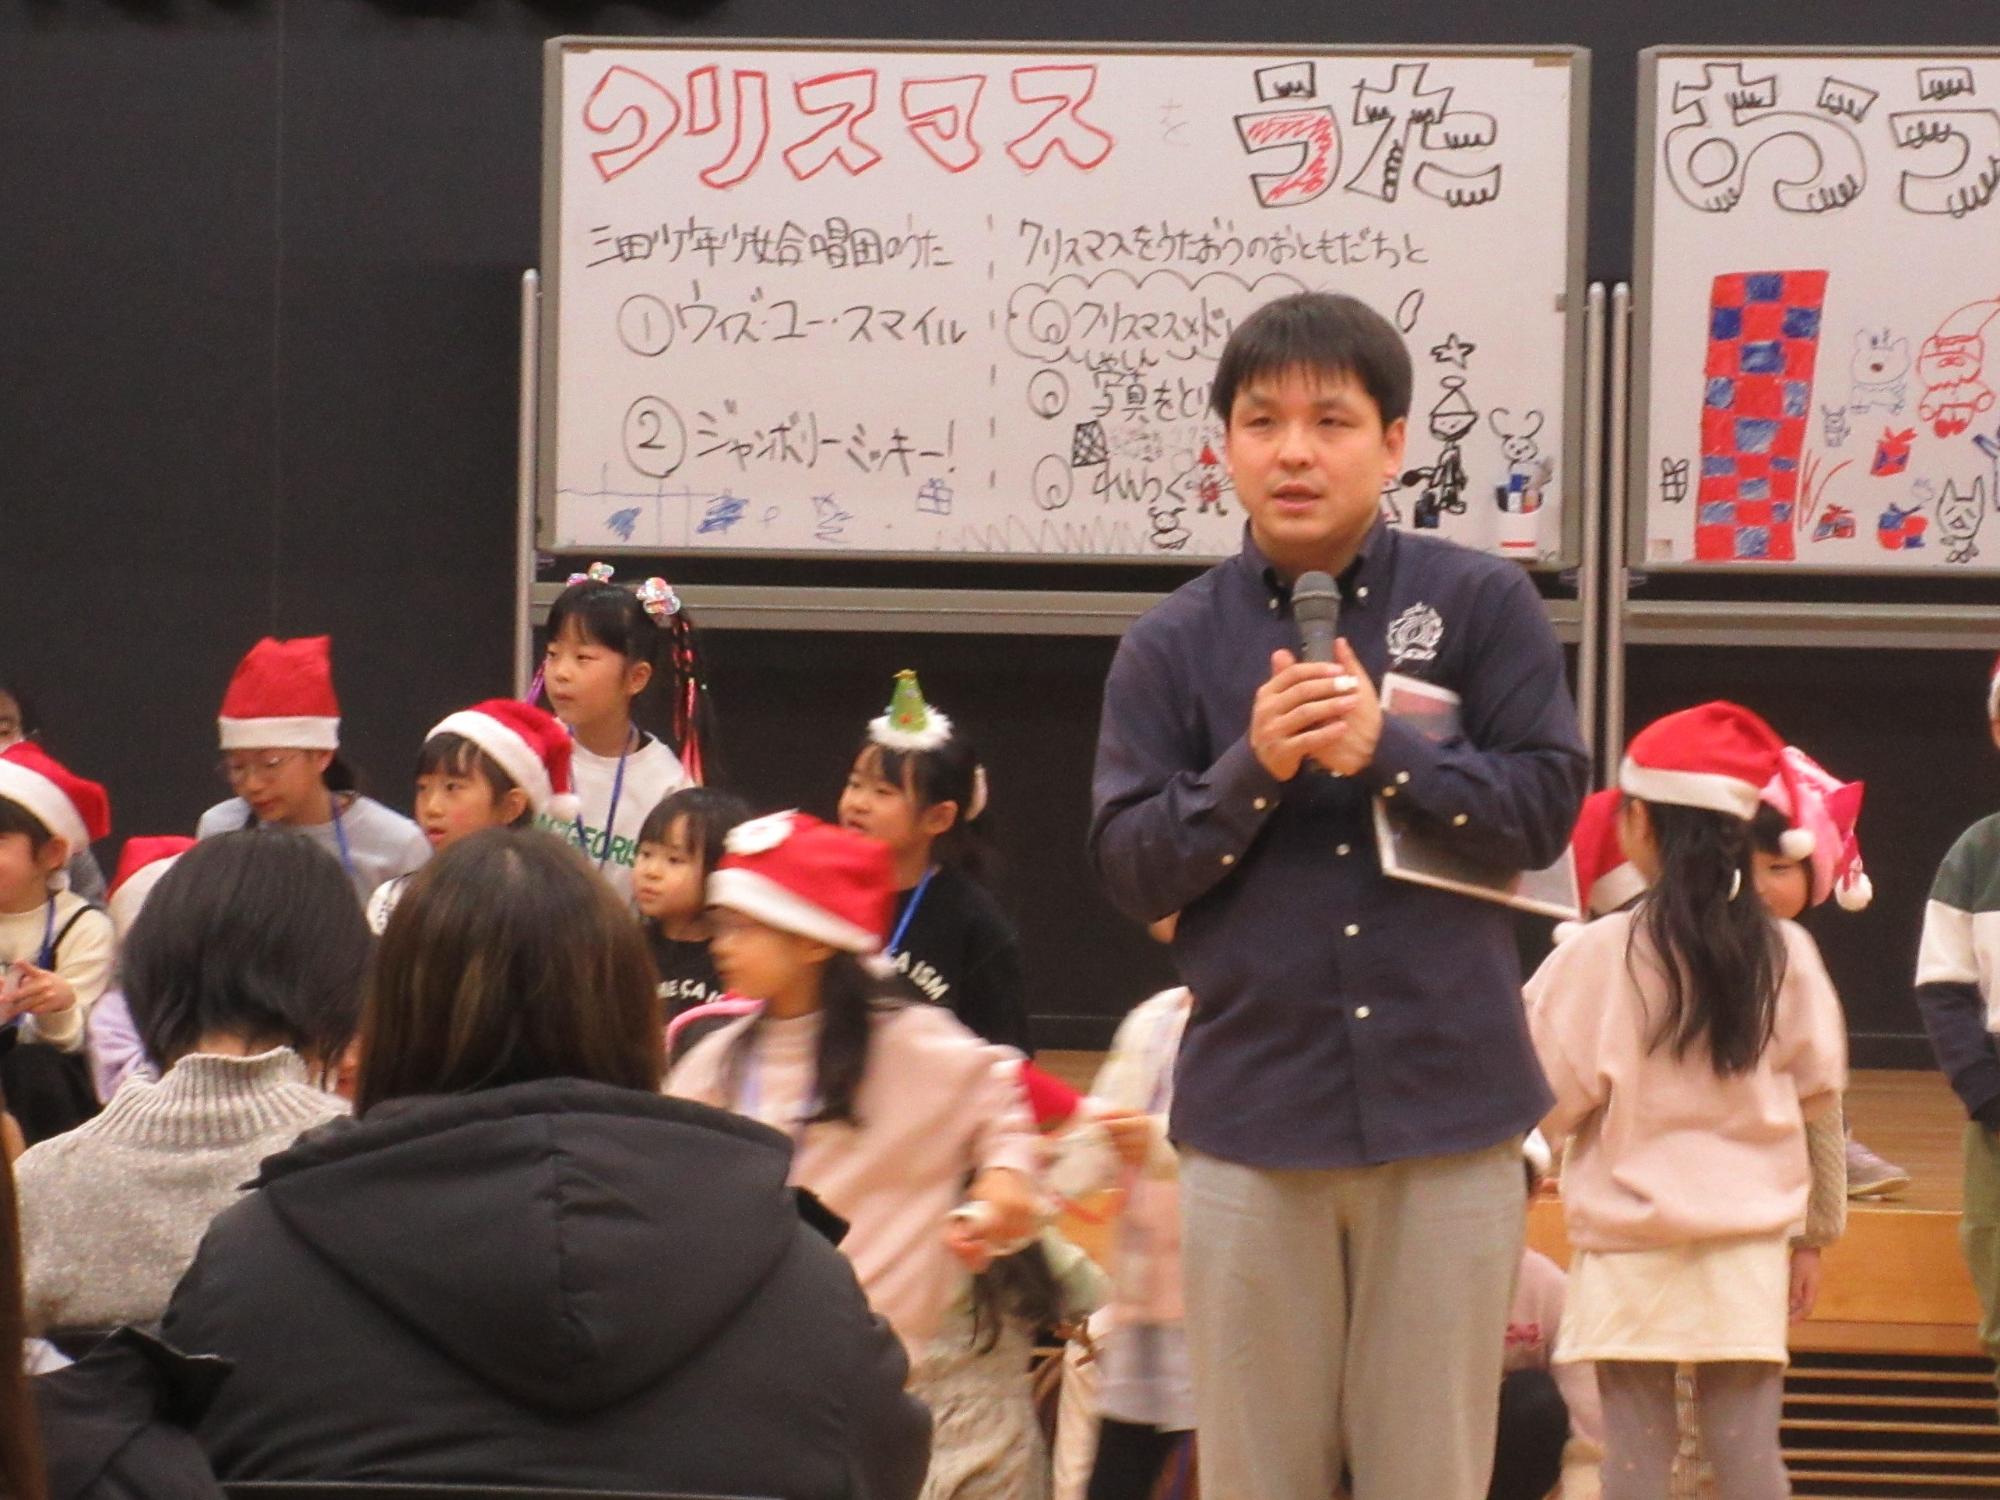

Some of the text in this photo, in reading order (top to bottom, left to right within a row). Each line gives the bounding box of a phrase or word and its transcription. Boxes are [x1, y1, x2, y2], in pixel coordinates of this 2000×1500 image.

[583, 64, 1114, 190] クリスマス
[1234, 61, 1502, 208] うた
